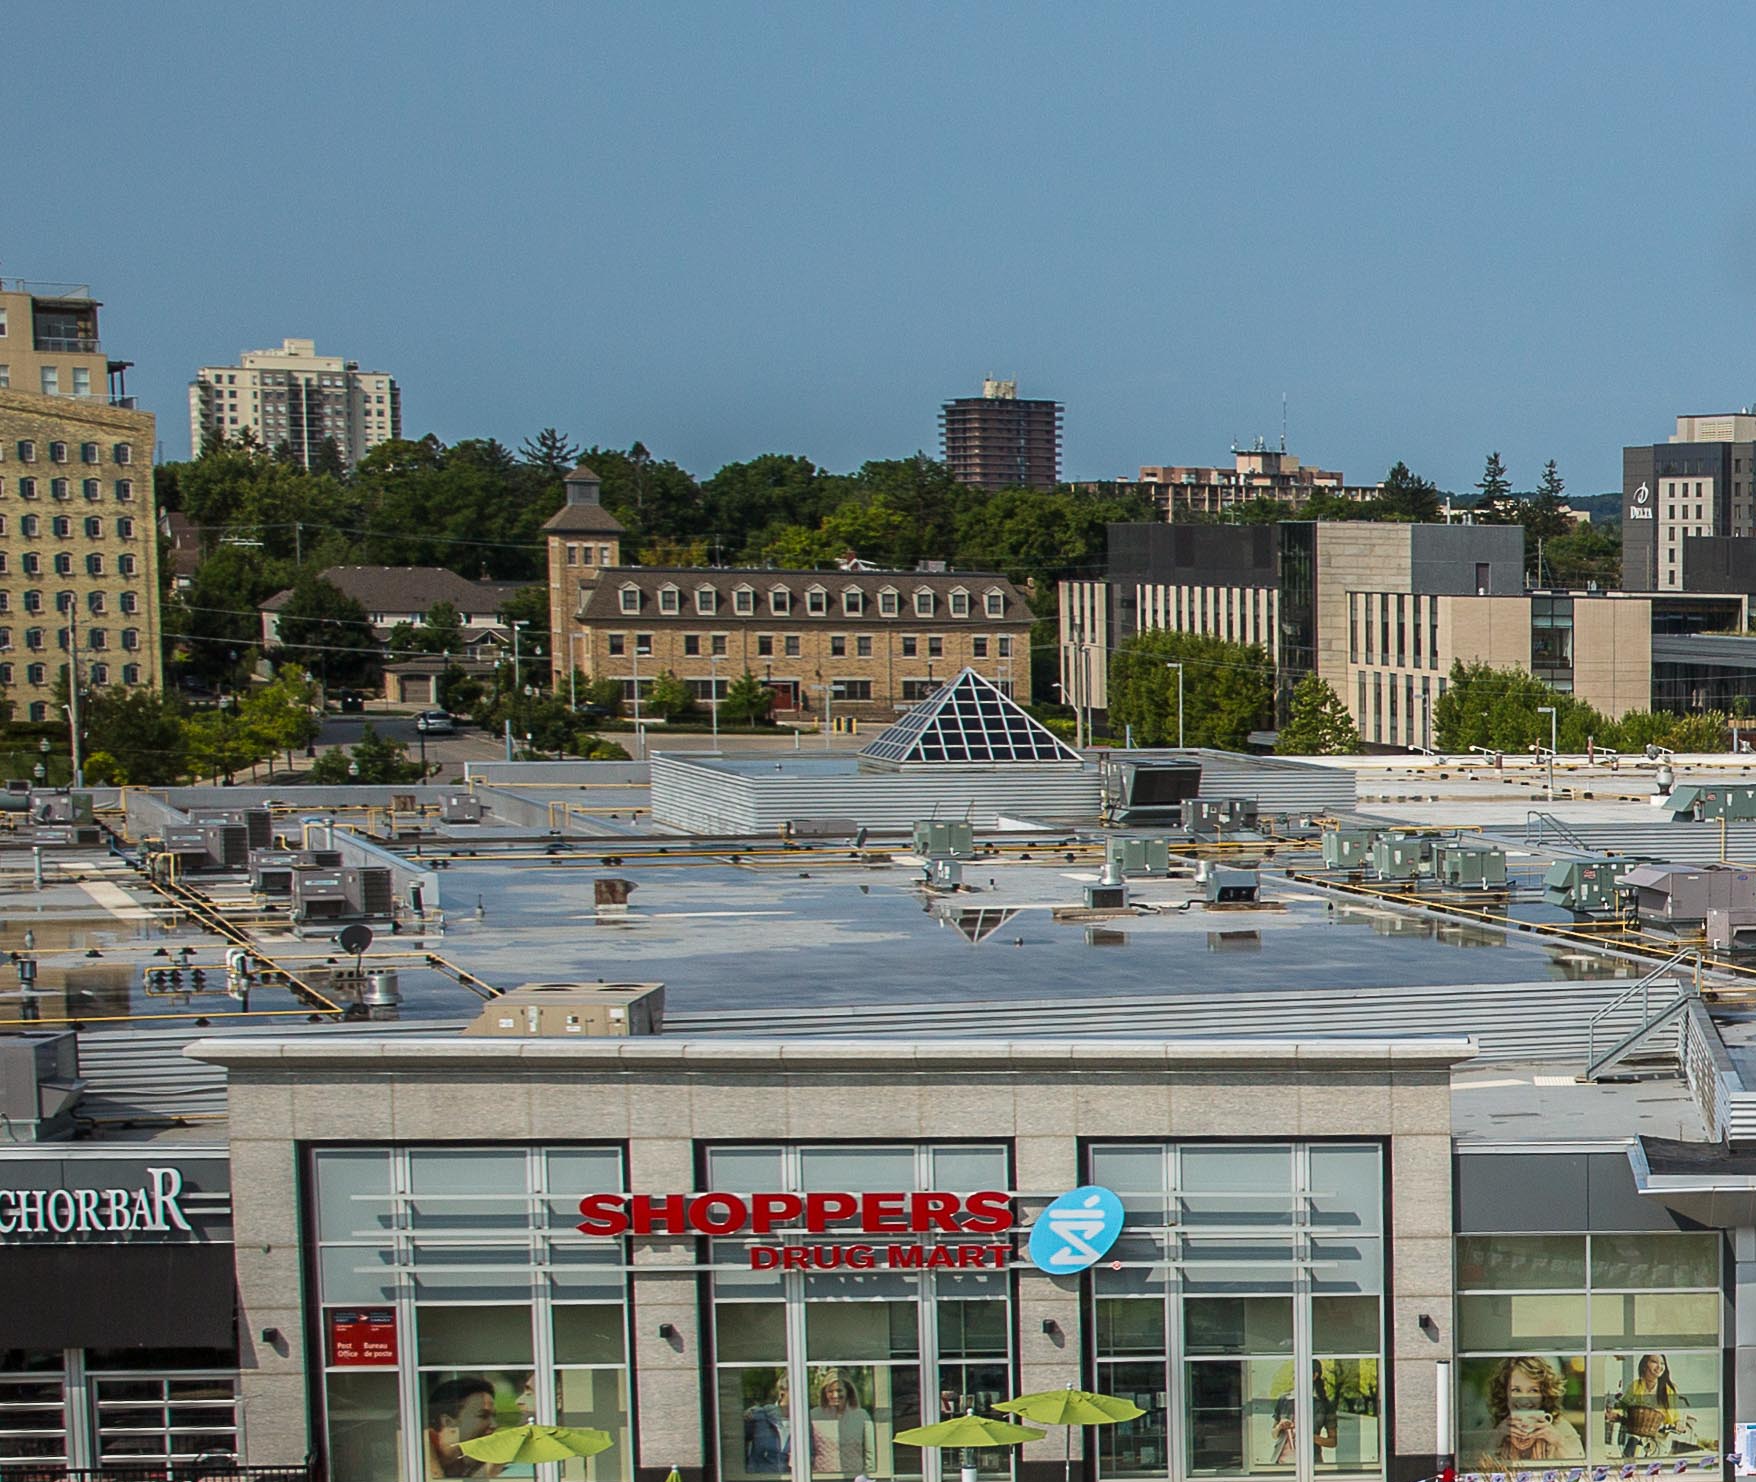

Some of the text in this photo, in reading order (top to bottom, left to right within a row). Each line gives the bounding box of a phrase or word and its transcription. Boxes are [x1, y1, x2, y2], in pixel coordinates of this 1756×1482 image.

[575, 1191, 1014, 1237] SHOPPERS
[749, 1244, 1013, 1271] DRUG MART
[337, 1342, 352, 1350] Post
[363, 1342, 388, 1350] Bureau
[337, 1351, 358, 1359] Office
